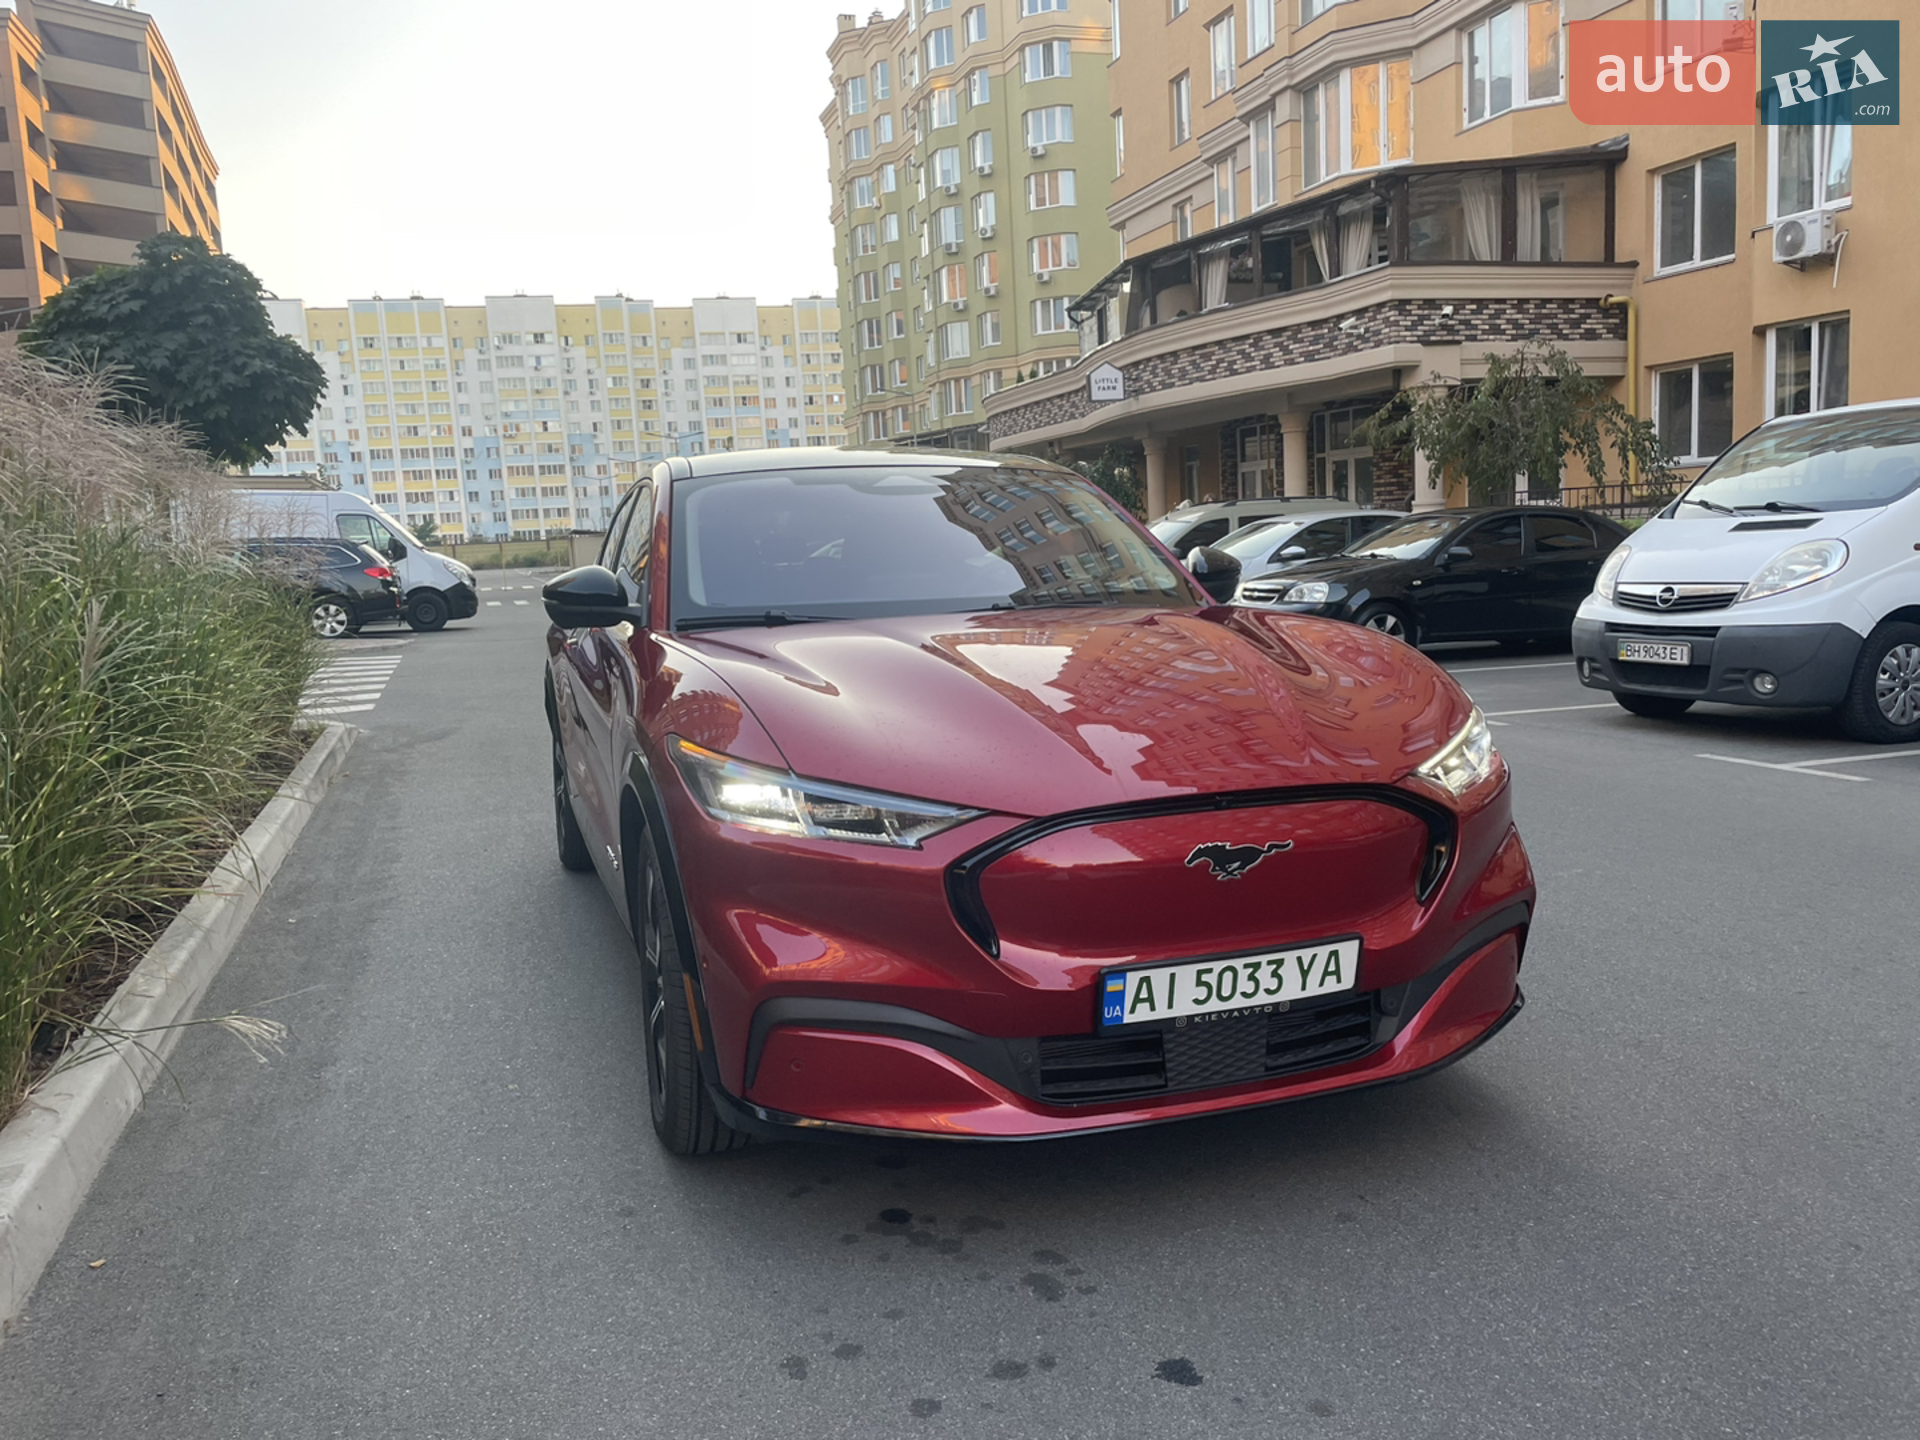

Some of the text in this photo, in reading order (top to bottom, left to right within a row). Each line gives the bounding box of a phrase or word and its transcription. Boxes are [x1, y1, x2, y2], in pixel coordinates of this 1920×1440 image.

[1626, 643, 1684, 661] BH 9043 EI
[1128, 949, 1342, 1015] AI 5033 YA
[1104, 1005, 1122, 1018] UA
[1194, 1005, 1273, 1023] KIEVAVTO
